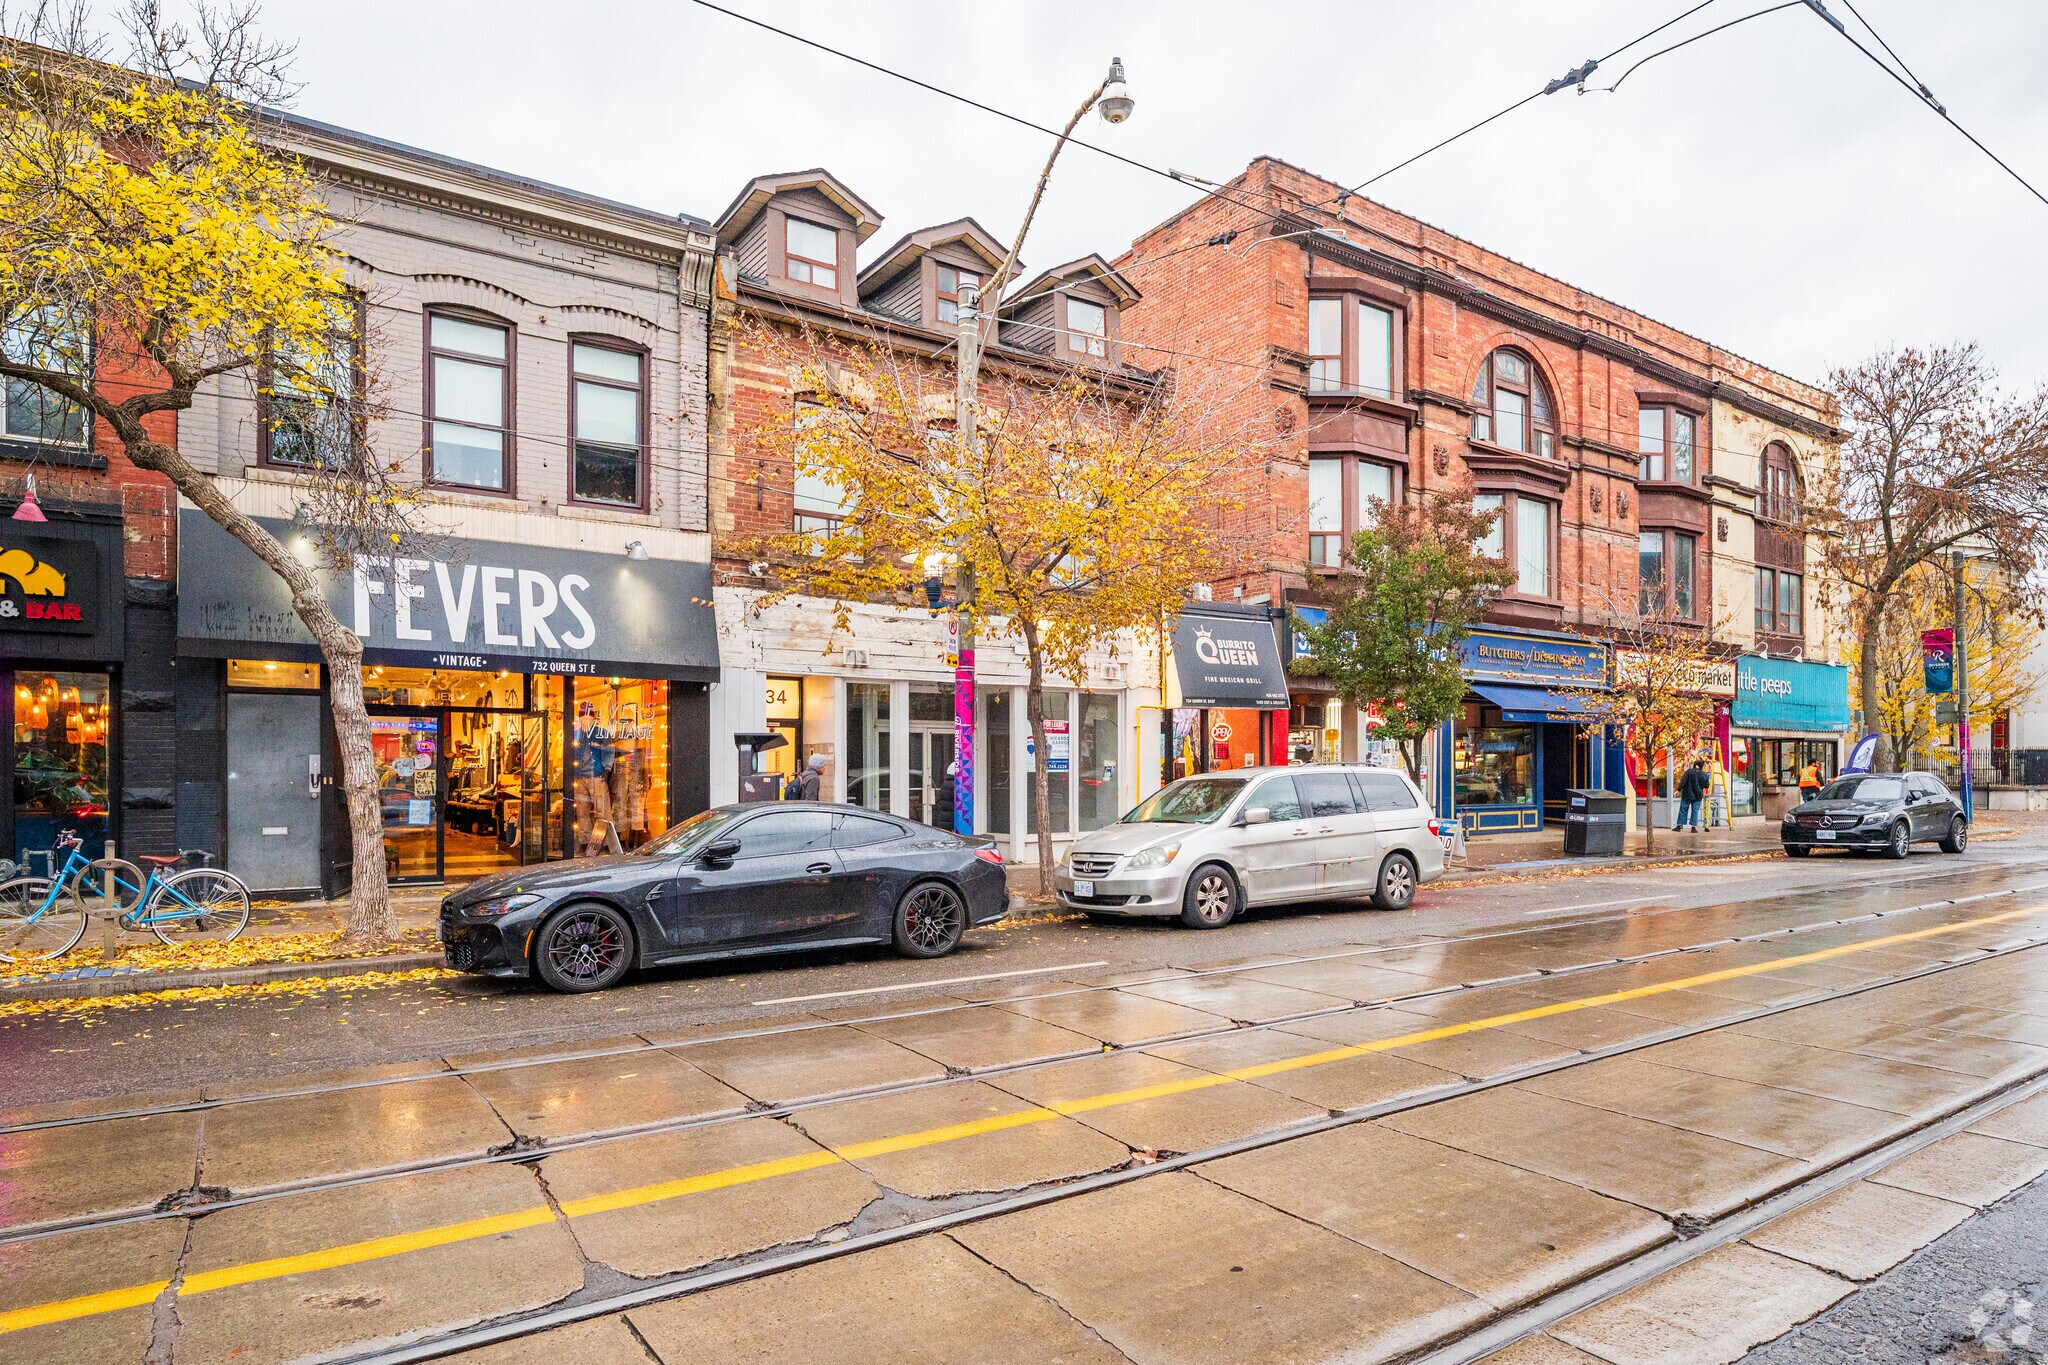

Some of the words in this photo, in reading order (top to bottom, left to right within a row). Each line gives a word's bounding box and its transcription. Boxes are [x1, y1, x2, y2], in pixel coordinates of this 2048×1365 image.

[0, 600, 20, 618] &
[25, 601, 83, 621] BAR
[353, 553, 596, 650] FEVERS
[1195, 636, 1259, 666] QUEEN
[1217, 639, 1255, 650] BURRITO
[532, 660, 548, 671] 732
[550, 662, 576, 673] QUEEN
[578, 664, 589, 673] ST
[590, 664, 596, 674] E
[1479, 645, 1525, 661] BUTCHERS
[1525, 646, 1536, 670] of
[1220, 676, 1245, 684] MEXICAN
[1699, 668, 1732, 687] market
[1760, 678, 1792, 700] peeps
[586, 720, 656, 740] VINTAGE
[1213, 726, 1231, 738] OPEN
